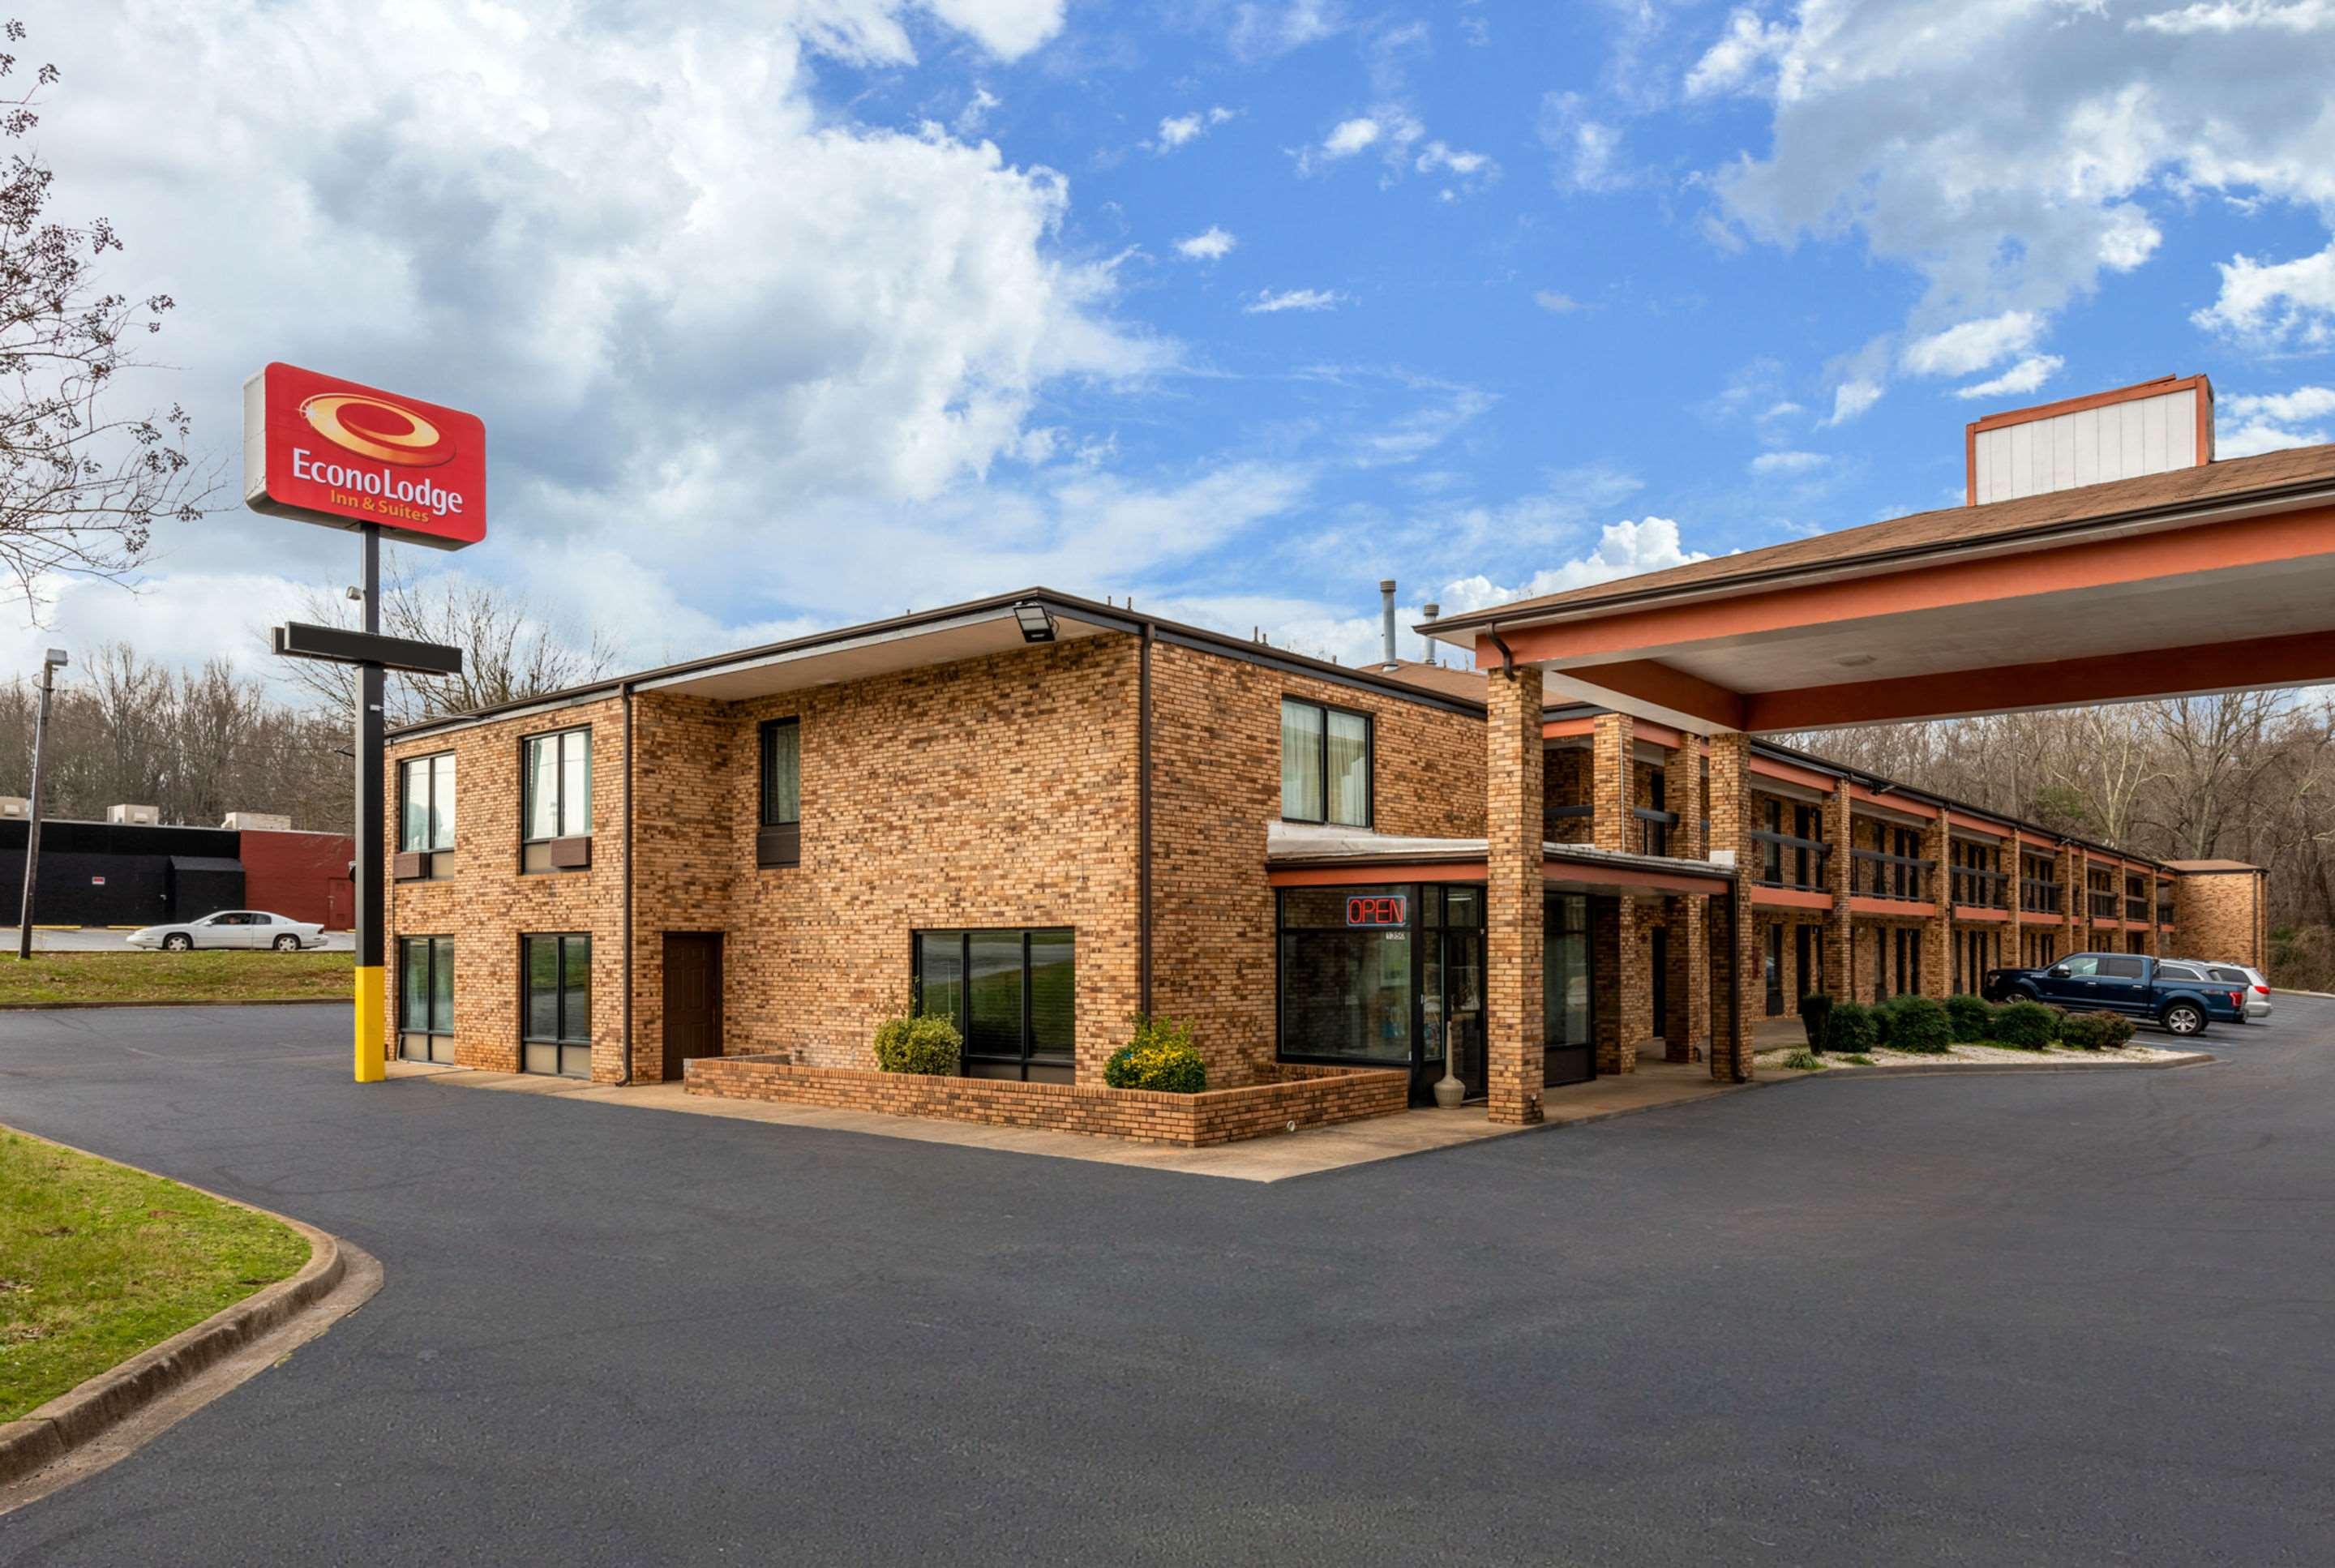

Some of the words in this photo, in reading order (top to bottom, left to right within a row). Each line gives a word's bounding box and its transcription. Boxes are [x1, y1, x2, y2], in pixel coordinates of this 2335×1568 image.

[293, 447, 464, 516] EconoLodge
[330, 489, 358, 508] Inn
[362, 496, 376, 512] &
[378, 499, 430, 523] Suites
[1348, 898, 1404, 923] OPEN
